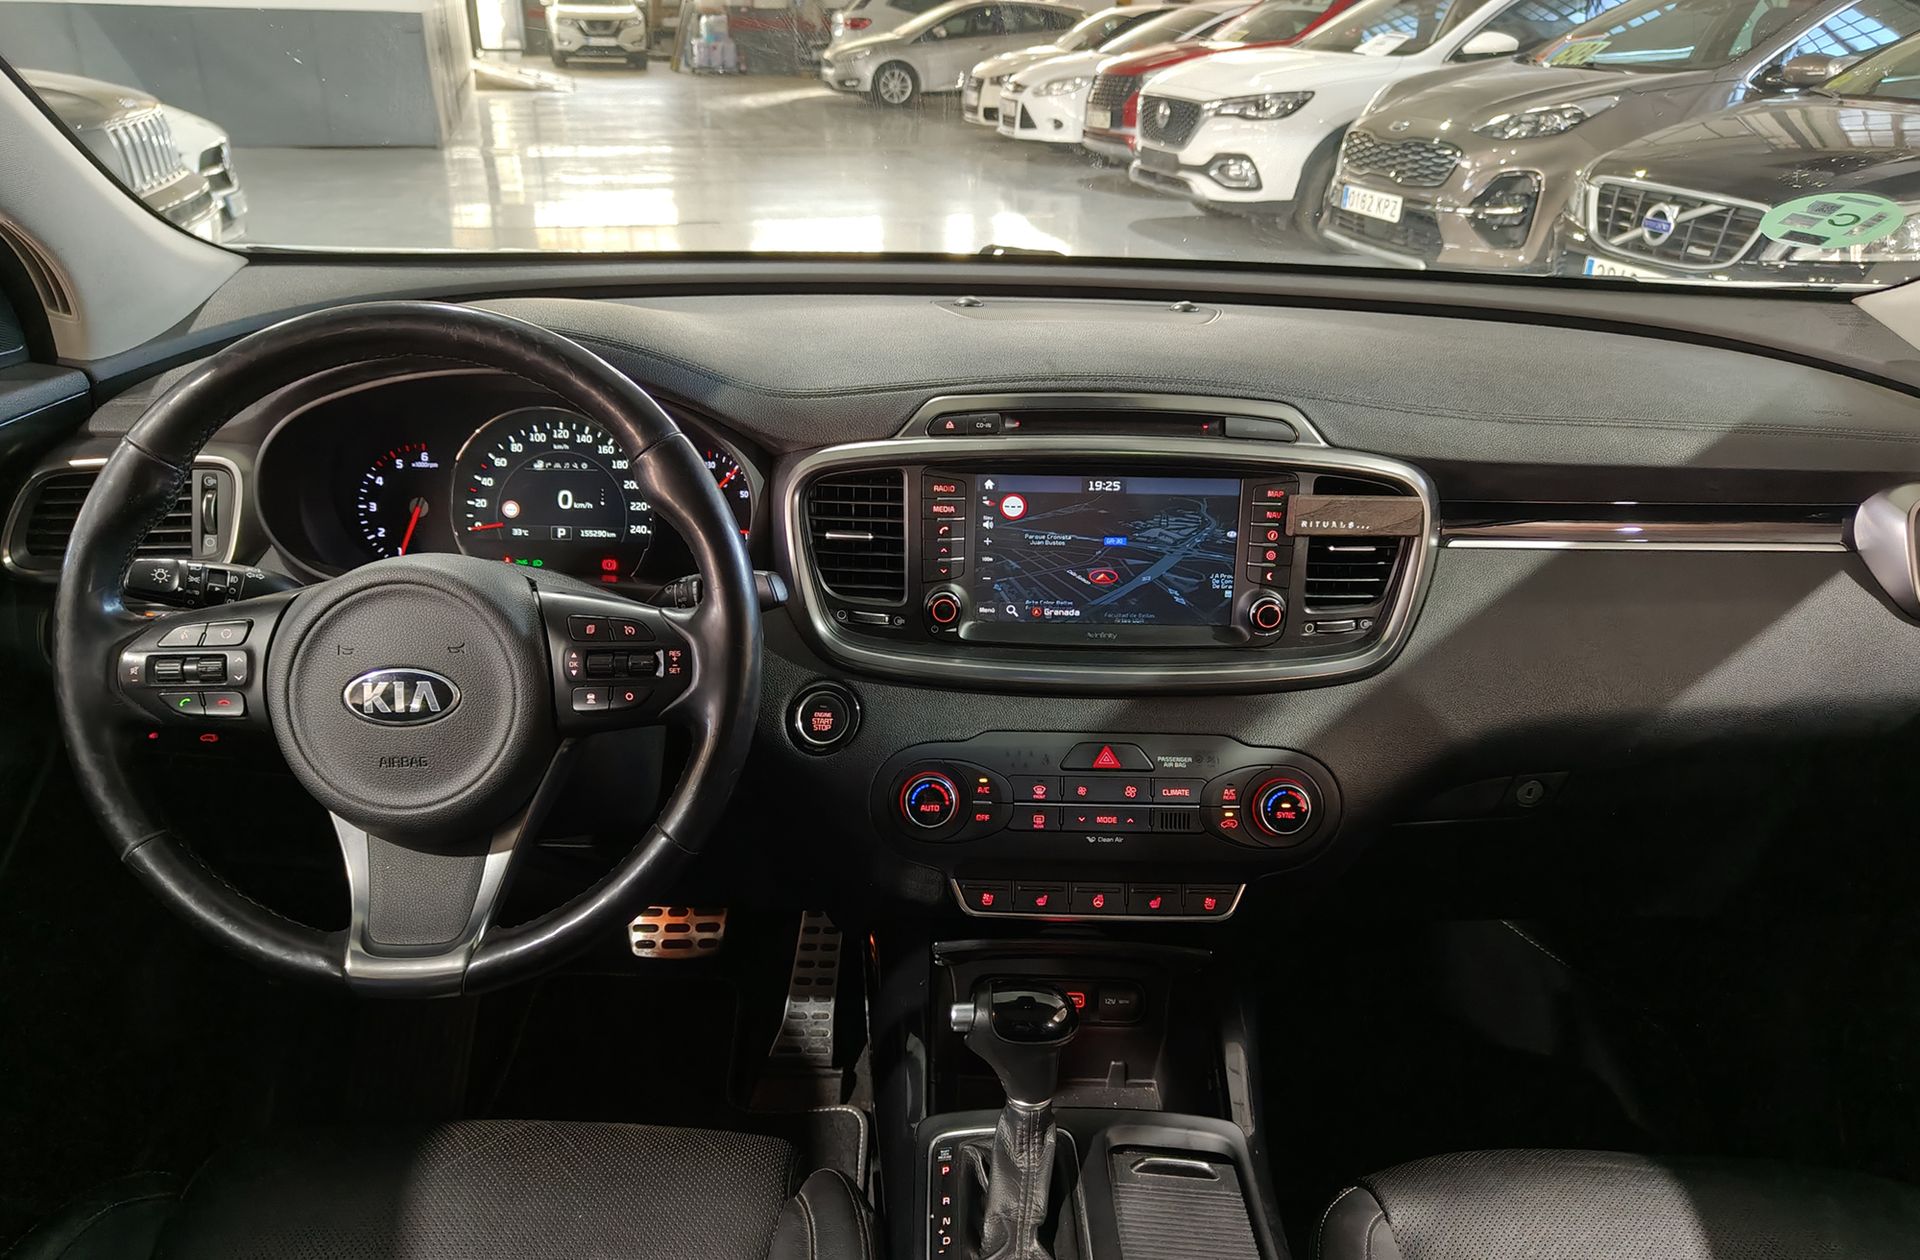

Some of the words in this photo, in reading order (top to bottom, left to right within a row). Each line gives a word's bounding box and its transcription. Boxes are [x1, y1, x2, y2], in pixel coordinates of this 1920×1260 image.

[529, 433, 547, 442] 100
[552, 429, 570, 439] 120
[576, 434, 593, 443] 140
[510, 443, 523, 453] 80
[598, 445, 615, 454] 160
[420, 451, 429, 461] 6
[395, 458, 404, 469] 5
[493, 458, 508, 467] 60
[611, 460, 629, 469] 180
[375, 476, 384, 486] 4
[480, 477, 494, 486] 40
[933, 484, 956, 492] RADIO
[1088, 480, 1121, 492] 19:25
[739, 490, 749, 498] 50
[1267, 490, 1285, 498] MAP
[474, 499, 487, 508] 20
[557, 490, 573, 509] 0
[368, 502, 377, 512] 3
[630, 502, 647, 511] 220
[933, 505, 955, 513] MEDIA
[1266, 511, 1282, 519] NAV
[377, 527, 386, 537] 2
[557, 527, 566, 539] P
[630, 525, 647, 534] 240
[1024, 533, 1046, 541] Parque
[1044, 608, 1080, 617] Granada
[361, 681, 441, 713] KIA
[812, 717, 833, 725] START
[379, 756, 428, 768] AIRBAG
[977, 786, 990, 794] A/C
[1162, 788, 1190, 796] CLIMATE
[1223, 788, 1236, 796] A/C
[920, 804, 940, 812] AUTO
[1276, 811, 1296, 819] SYNC
[1097, 835, 1114, 843] Clean
[942, 1166, 950, 1175] P
[942, 1217, 951, 1226] N
[942, 1236, 951, 1245] D
